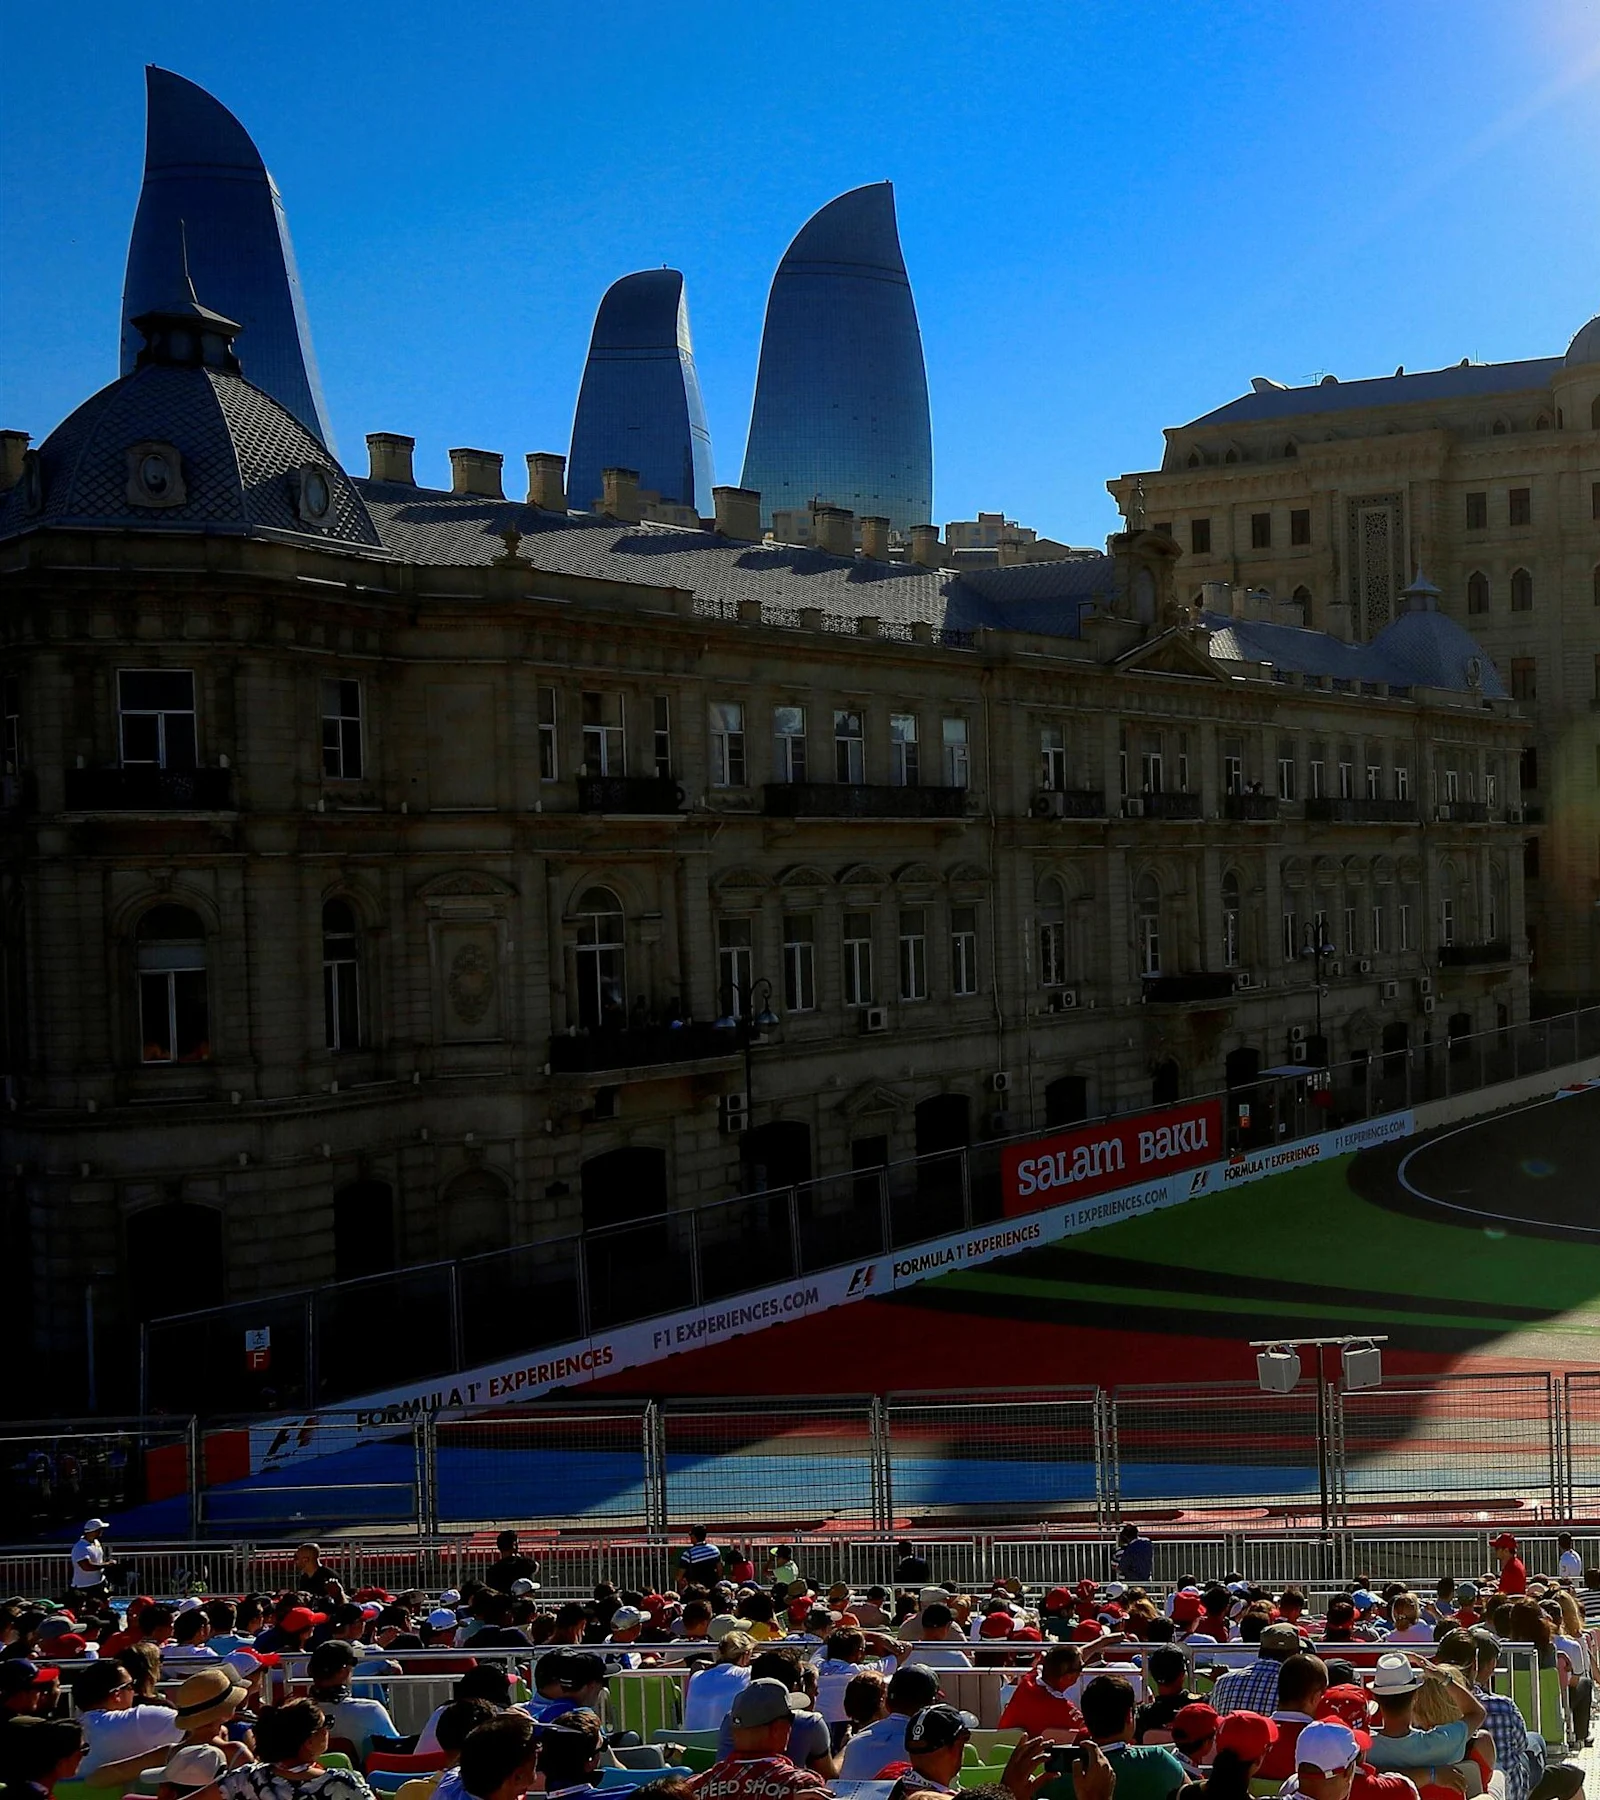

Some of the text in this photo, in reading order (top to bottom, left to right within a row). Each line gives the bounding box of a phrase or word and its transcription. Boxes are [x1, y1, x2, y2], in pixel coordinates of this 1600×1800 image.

[1345, 1120, 1405, 1145] EXPERIENCES.COM
[1224, 1159, 1264, 1181] FORMULA
[1272, 1144, 1320, 1167] EXPERIENCES
[1064, 1188, 1168, 1228] F1 EXPERIENCES.COM
[894, 1246, 954, 1278] FORMULA
[967, 1224, 1040, 1257] EXPERIENCES
[653, 1287, 819, 1349] F1 EXPERIENCES.COM
[489, 1346, 613, 1397] EXPERIENCES
[743, 1779, 790, 1799] SHOP
